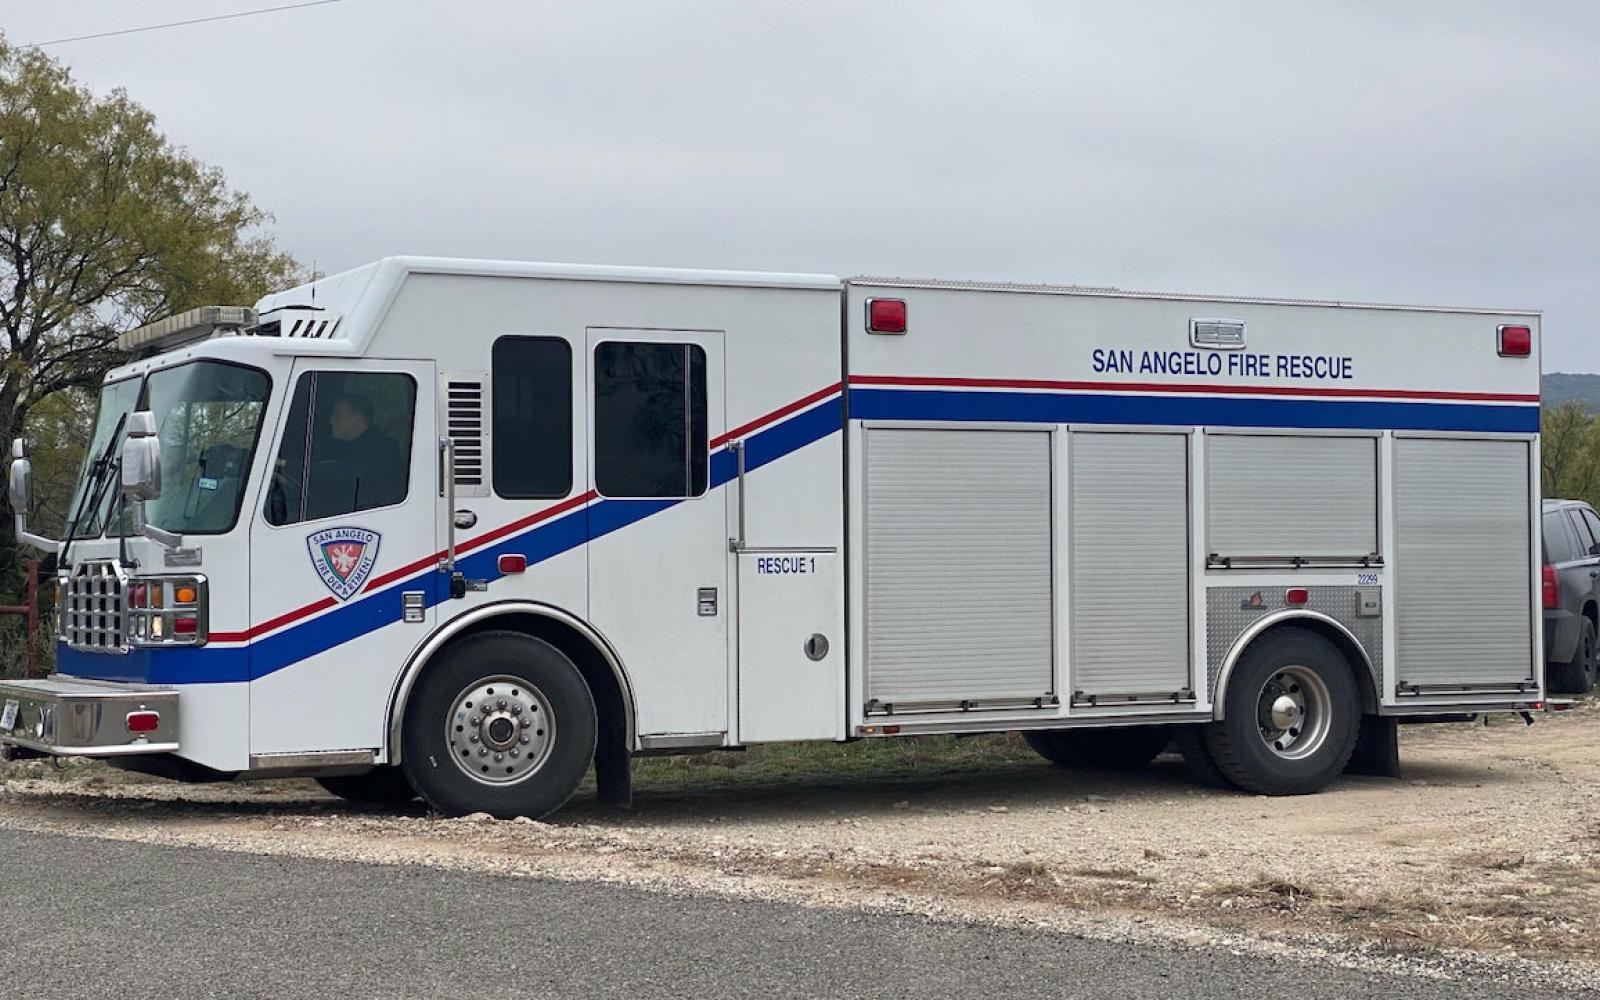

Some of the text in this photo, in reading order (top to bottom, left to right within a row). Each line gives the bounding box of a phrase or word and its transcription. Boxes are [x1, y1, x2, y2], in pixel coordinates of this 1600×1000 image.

[1092, 349, 1353, 379] SAN ANGELO FIRE RESCUE
[313, 529, 373, 545] SAN ANGELO
[316, 556, 373, 595] FIRE DEPARTMENT
[757, 557, 815, 574] RESCUE 1
